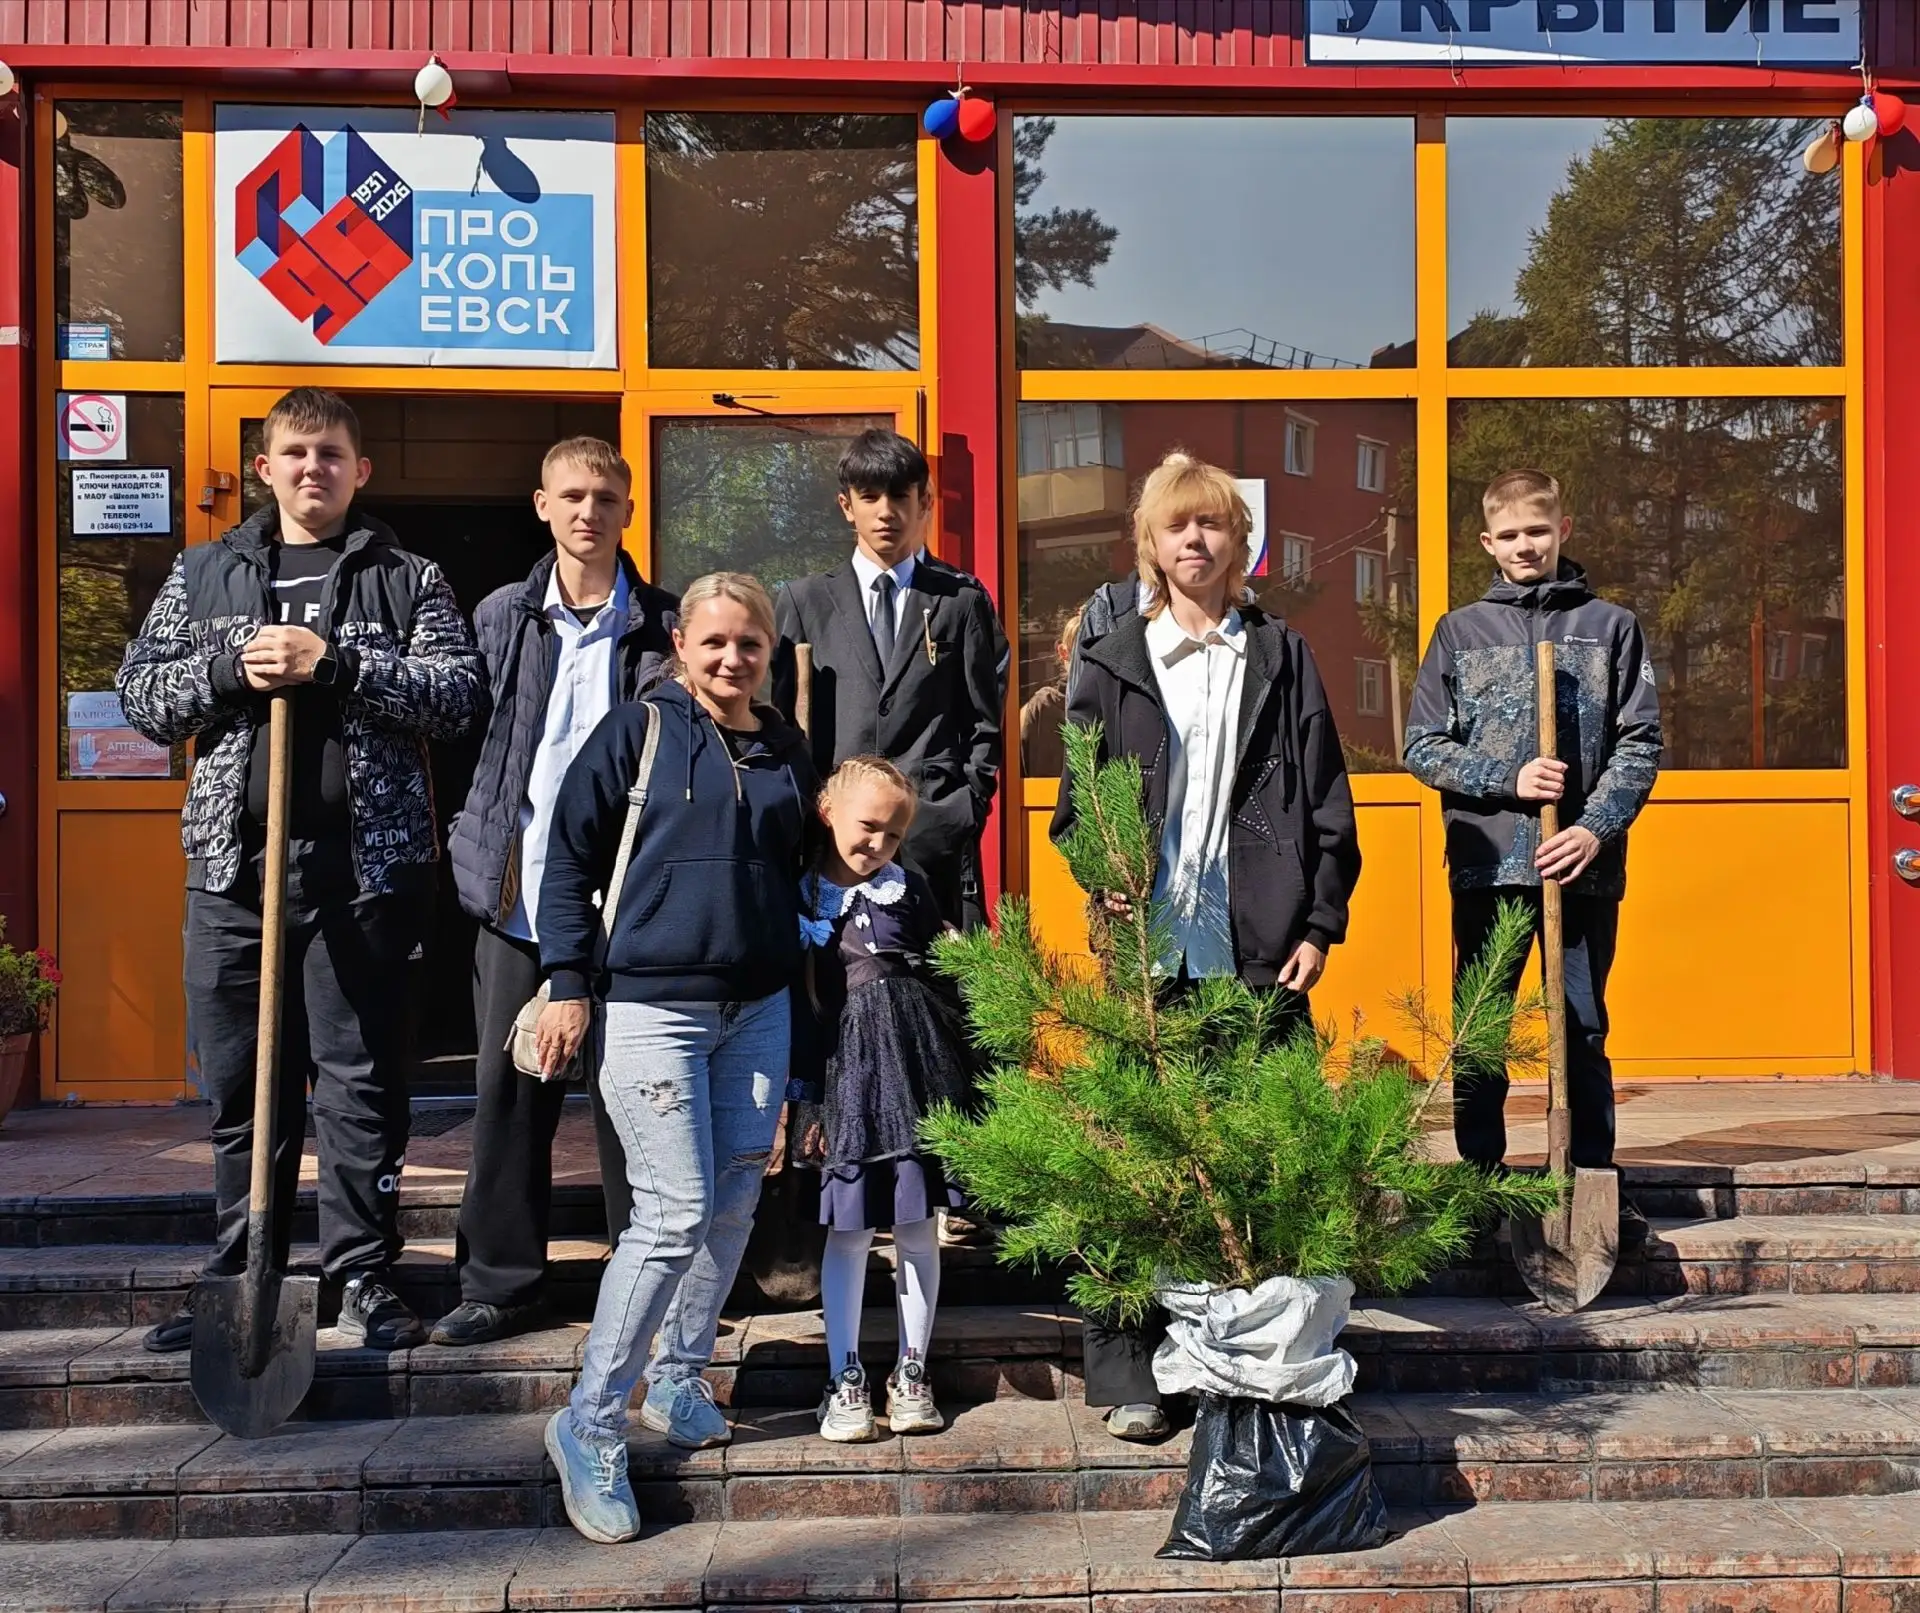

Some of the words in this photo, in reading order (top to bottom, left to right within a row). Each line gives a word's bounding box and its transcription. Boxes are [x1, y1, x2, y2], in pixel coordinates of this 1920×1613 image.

[351, 170, 388, 205] 1931
[369, 181, 412, 222] 2026
[420, 208, 539, 248] ПРО
[420, 251, 576, 292] КОПЬ
[420, 295, 572, 335] ЕВСК
[79, 482, 110, 490] КЛЮЧИ
[111, 482, 163, 491] НАХОДЯТСЯ:
[89, 472, 138, 481] Пионерская,
[102, 512, 141, 520] ТЕЛЕФОН
[107, 742, 161, 753] АПТЕЧКА
[364, 828, 410, 847] WEIDN
